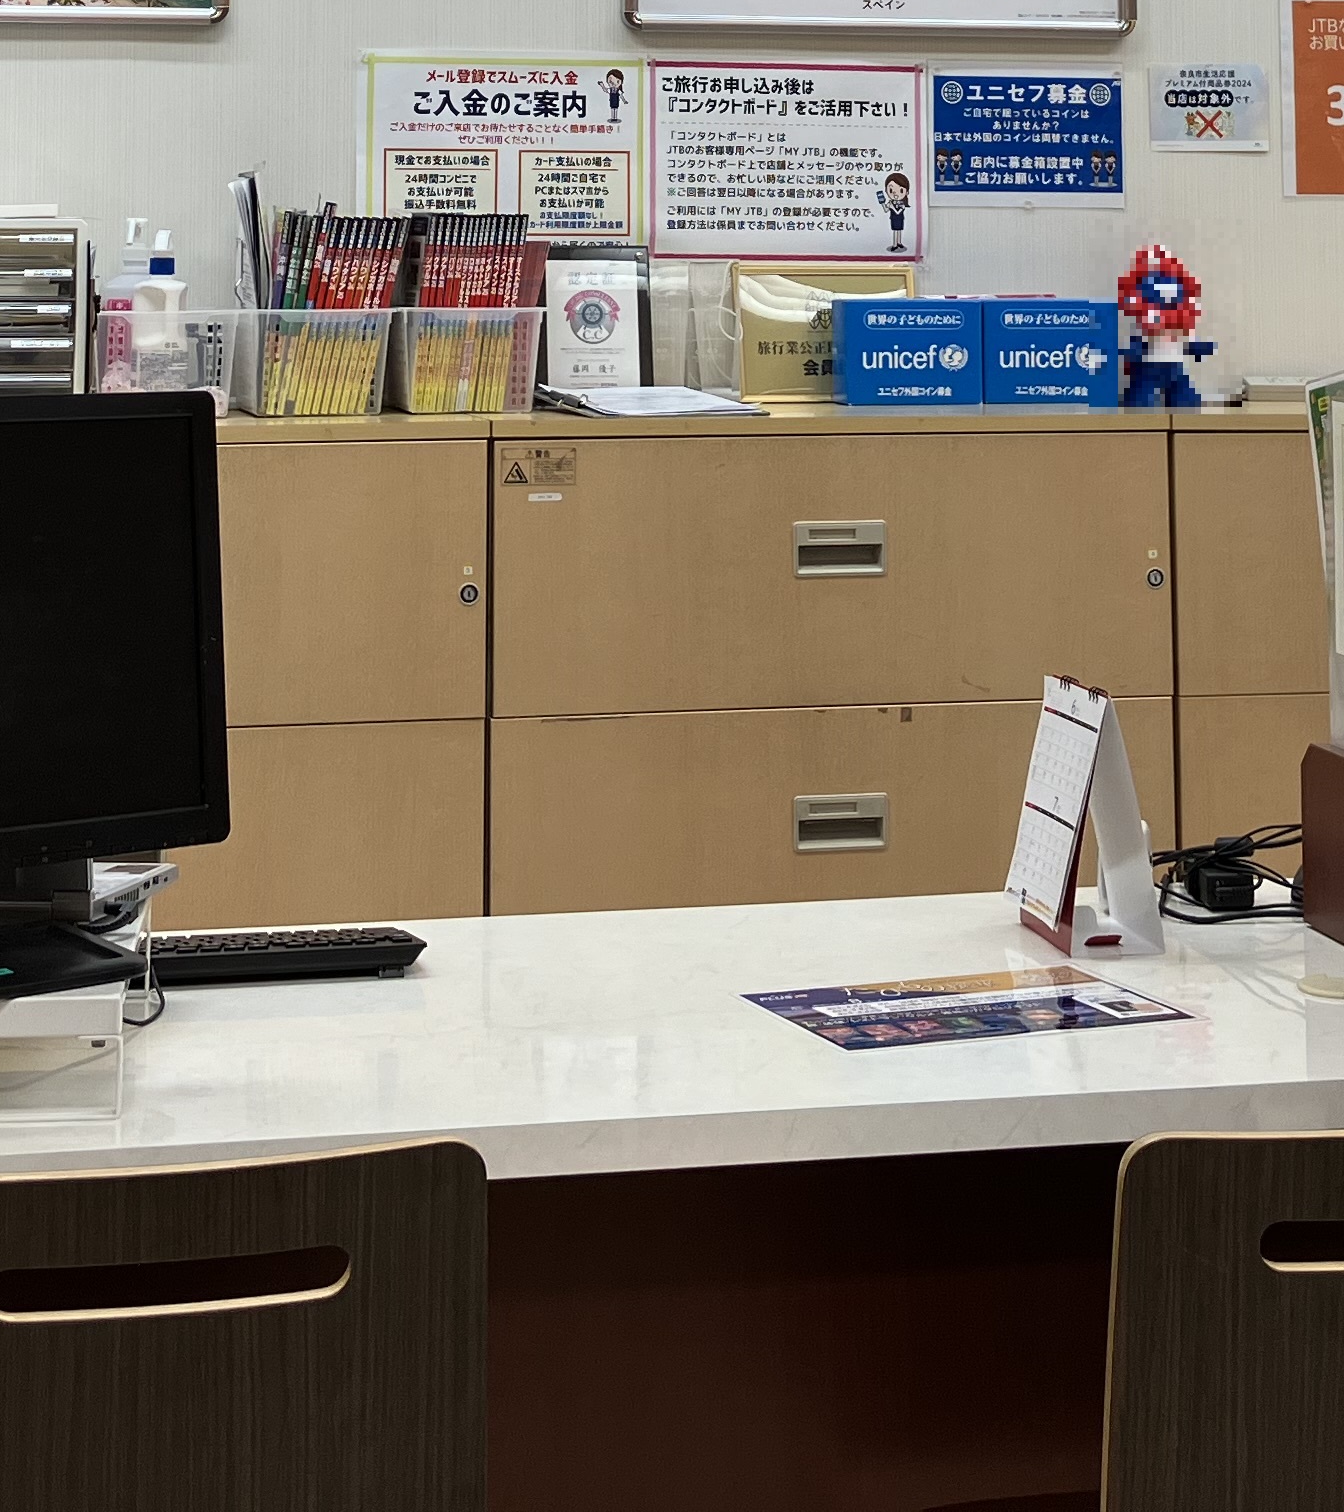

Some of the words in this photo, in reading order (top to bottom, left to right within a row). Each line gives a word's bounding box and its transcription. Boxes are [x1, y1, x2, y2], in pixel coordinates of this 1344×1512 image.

[862, 0, 906, 10] スペイン
[426, 69, 579, 85] メール登録でスムーズに入金
[662, 76, 815, 95] ご旅行お申し込み後は
[966, 83, 1087, 104] ユニセフ募金
[413, 89, 587, 118] ご入金のご案内
[670, 131, 786, 143] 「コンタクトボード」とは
[394, 155, 491, 166] 現金でお支払いの場合
[534, 156, 613, 167] カード支払いの場合
[404, 173, 477, 184] 24時間コンビニで
[964, 171, 1084, 186] ご協力お願いします。
[407, 186, 474, 197] お支払いが可能
[404, 199, 477, 210] 振込手数料無料
[539, 198, 605, 208] お支払いが可能
[867, 314, 961, 326] 世界の子どものために
[862, 343, 938, 369] unicef
[999, 344, 1075, 369] unicef
